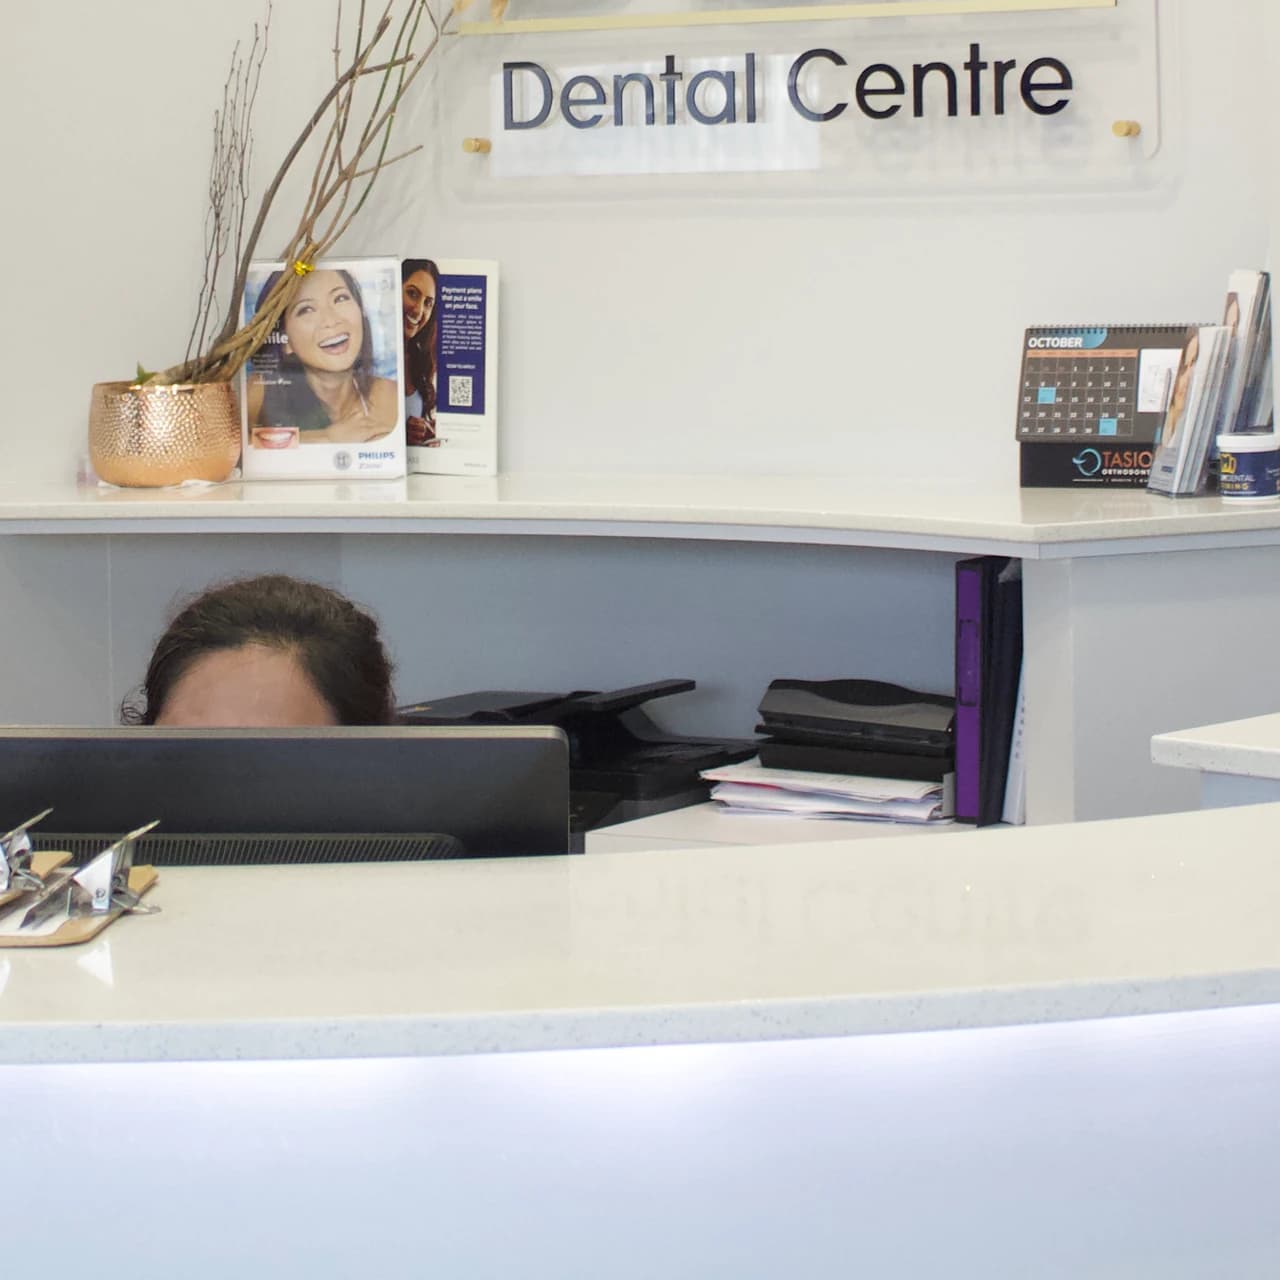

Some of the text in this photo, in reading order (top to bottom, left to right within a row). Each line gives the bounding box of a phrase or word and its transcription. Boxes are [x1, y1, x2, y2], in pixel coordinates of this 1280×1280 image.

[502, 43, 1073, 131] Dental Centre
[1028, 337, 1083, 348] OCTOBER
[358, 451, 395, 460] PHILIPS
[1102, 451, 1153, 468] TASIO
[1101, 468, 1151, 476] ORTHODONT
